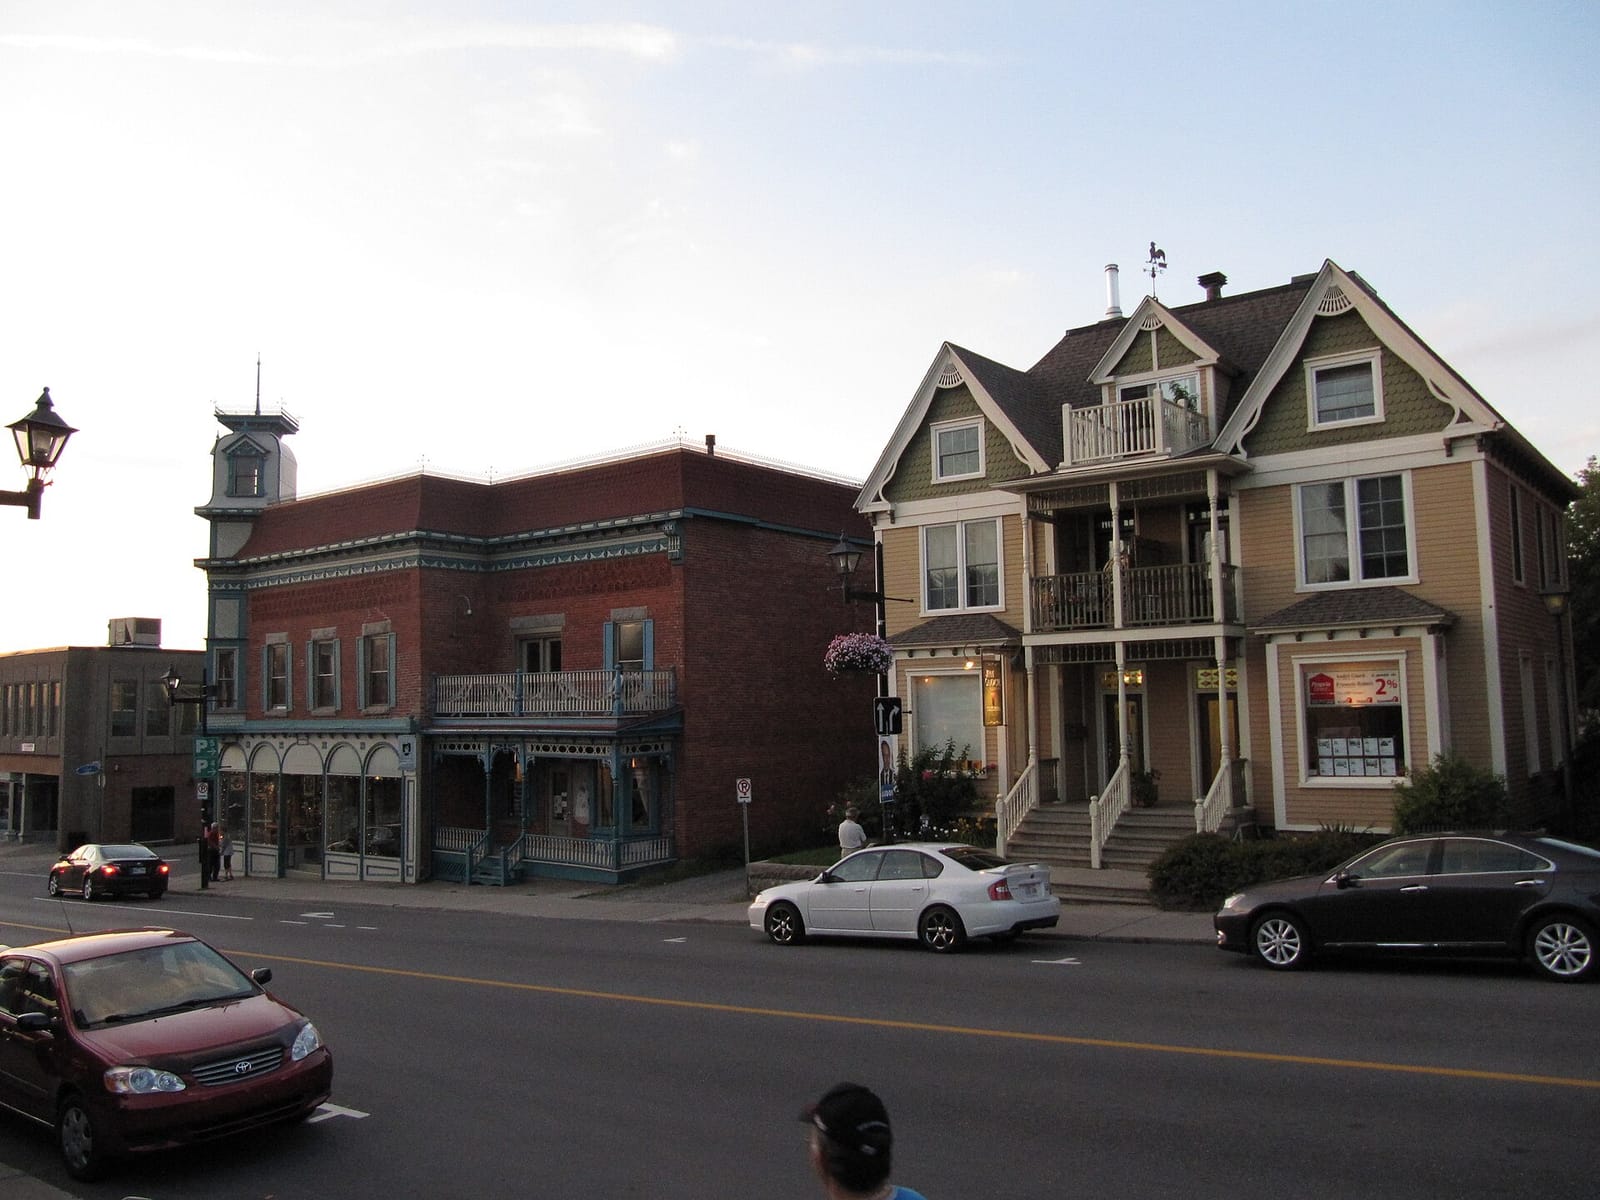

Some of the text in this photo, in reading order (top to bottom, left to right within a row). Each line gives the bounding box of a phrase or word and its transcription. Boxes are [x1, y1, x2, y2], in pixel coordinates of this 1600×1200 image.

[1376, 679, 1397, 695] 2%
[195, 739, 208, 753] P
[196, 759, 209, 773] P
